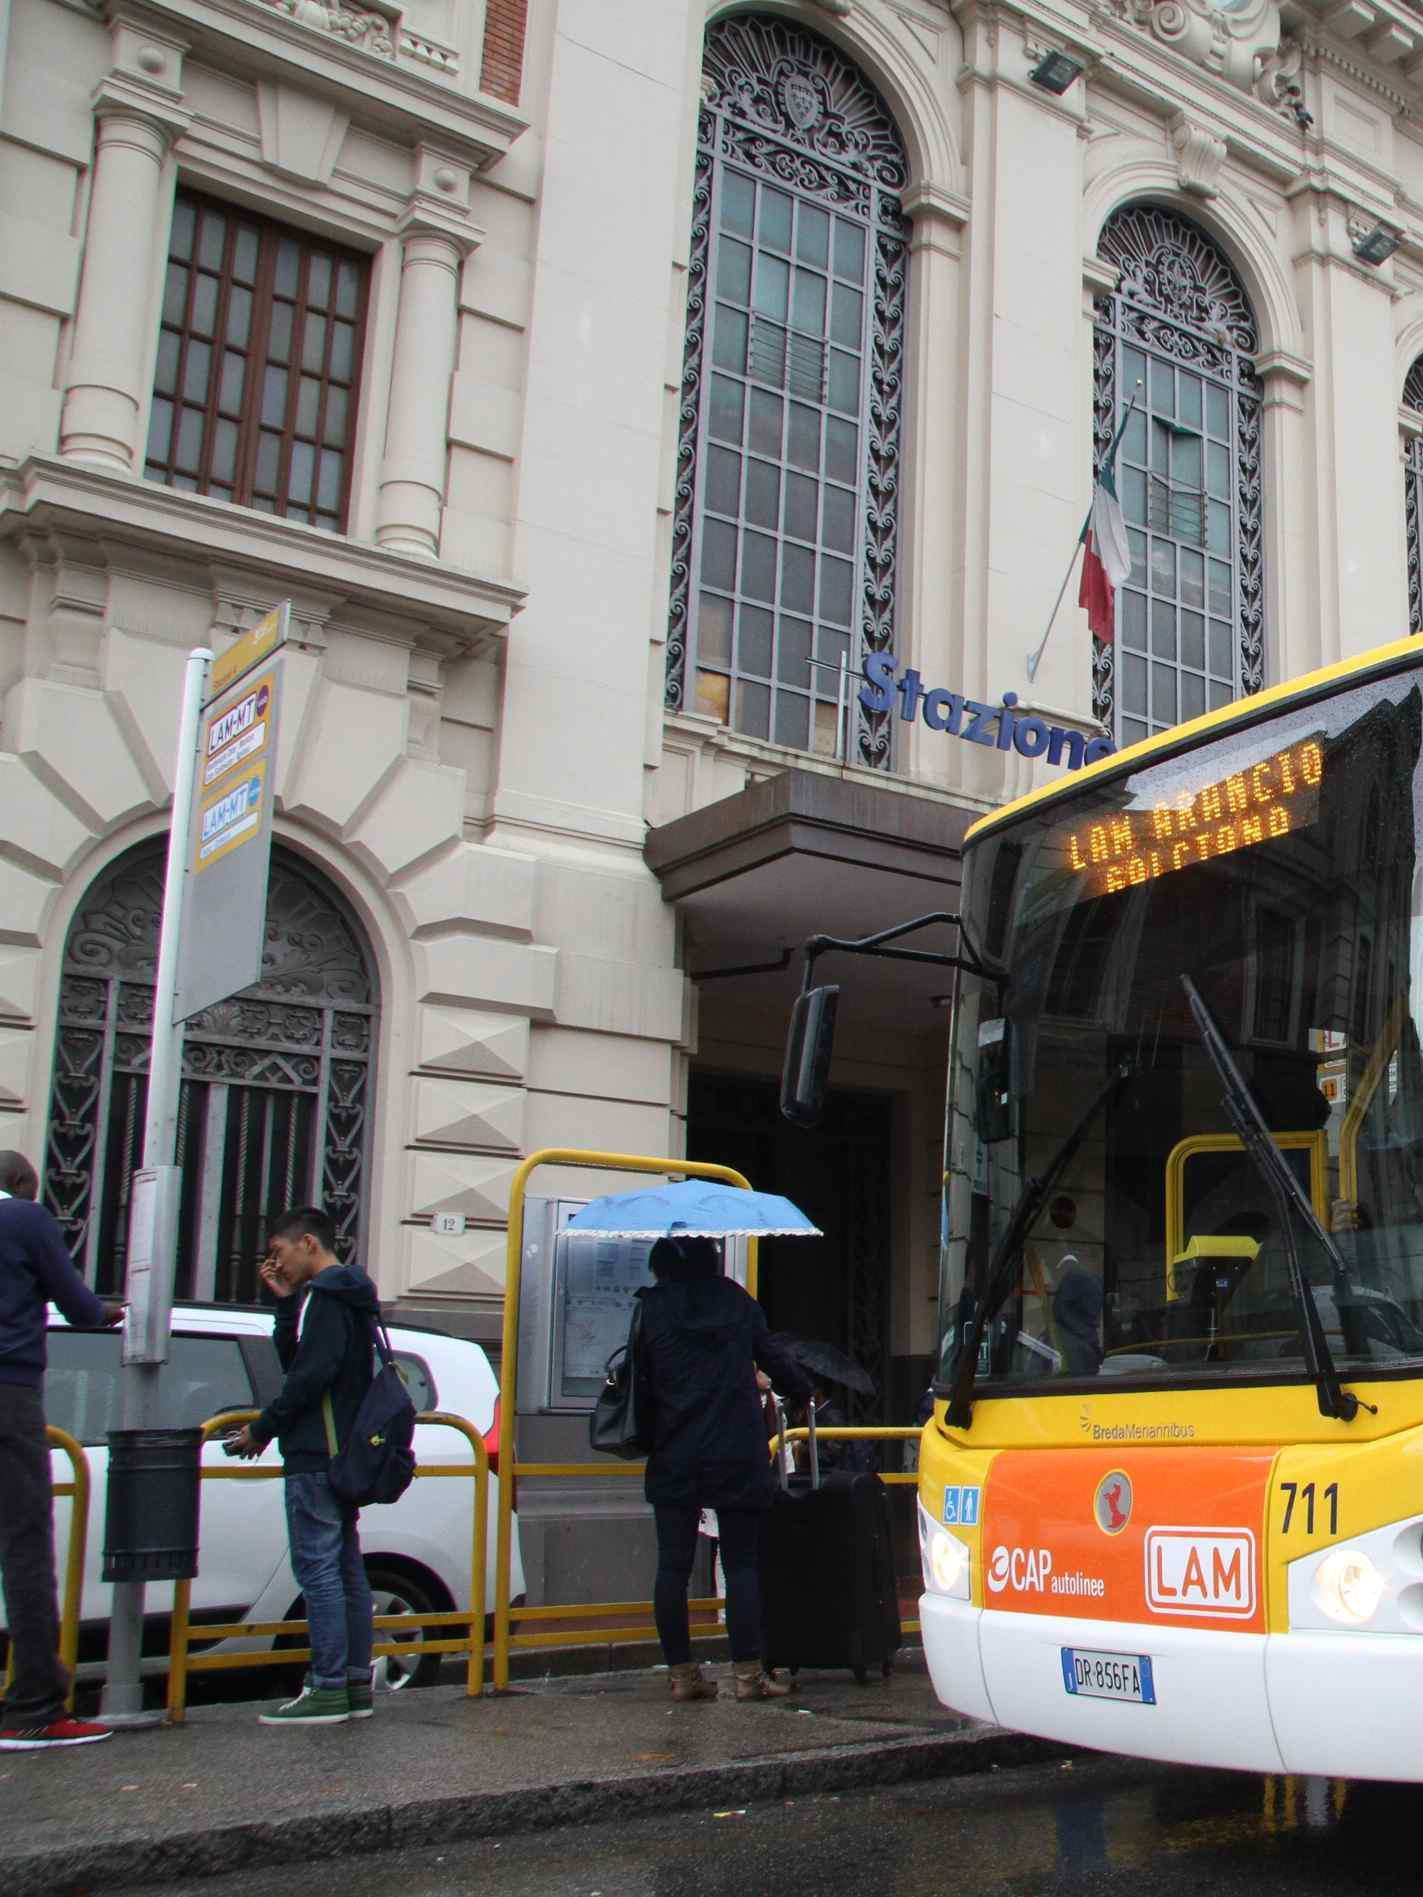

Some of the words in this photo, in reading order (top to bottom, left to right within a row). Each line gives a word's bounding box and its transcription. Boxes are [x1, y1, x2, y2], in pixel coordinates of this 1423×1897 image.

[1070, 815, 1133, 871] LAM
[1152, 742, 1324, 841] ARANCIO
[443, 1218, 457, 1231] 12
[1280, 1482, 1338, 1536] 711
[1010, 1546, 1052, 1593] CAP
[1051, 1571, 1105, 1598] autolinee
[1155, 1544, 1242, 1601] LAM
